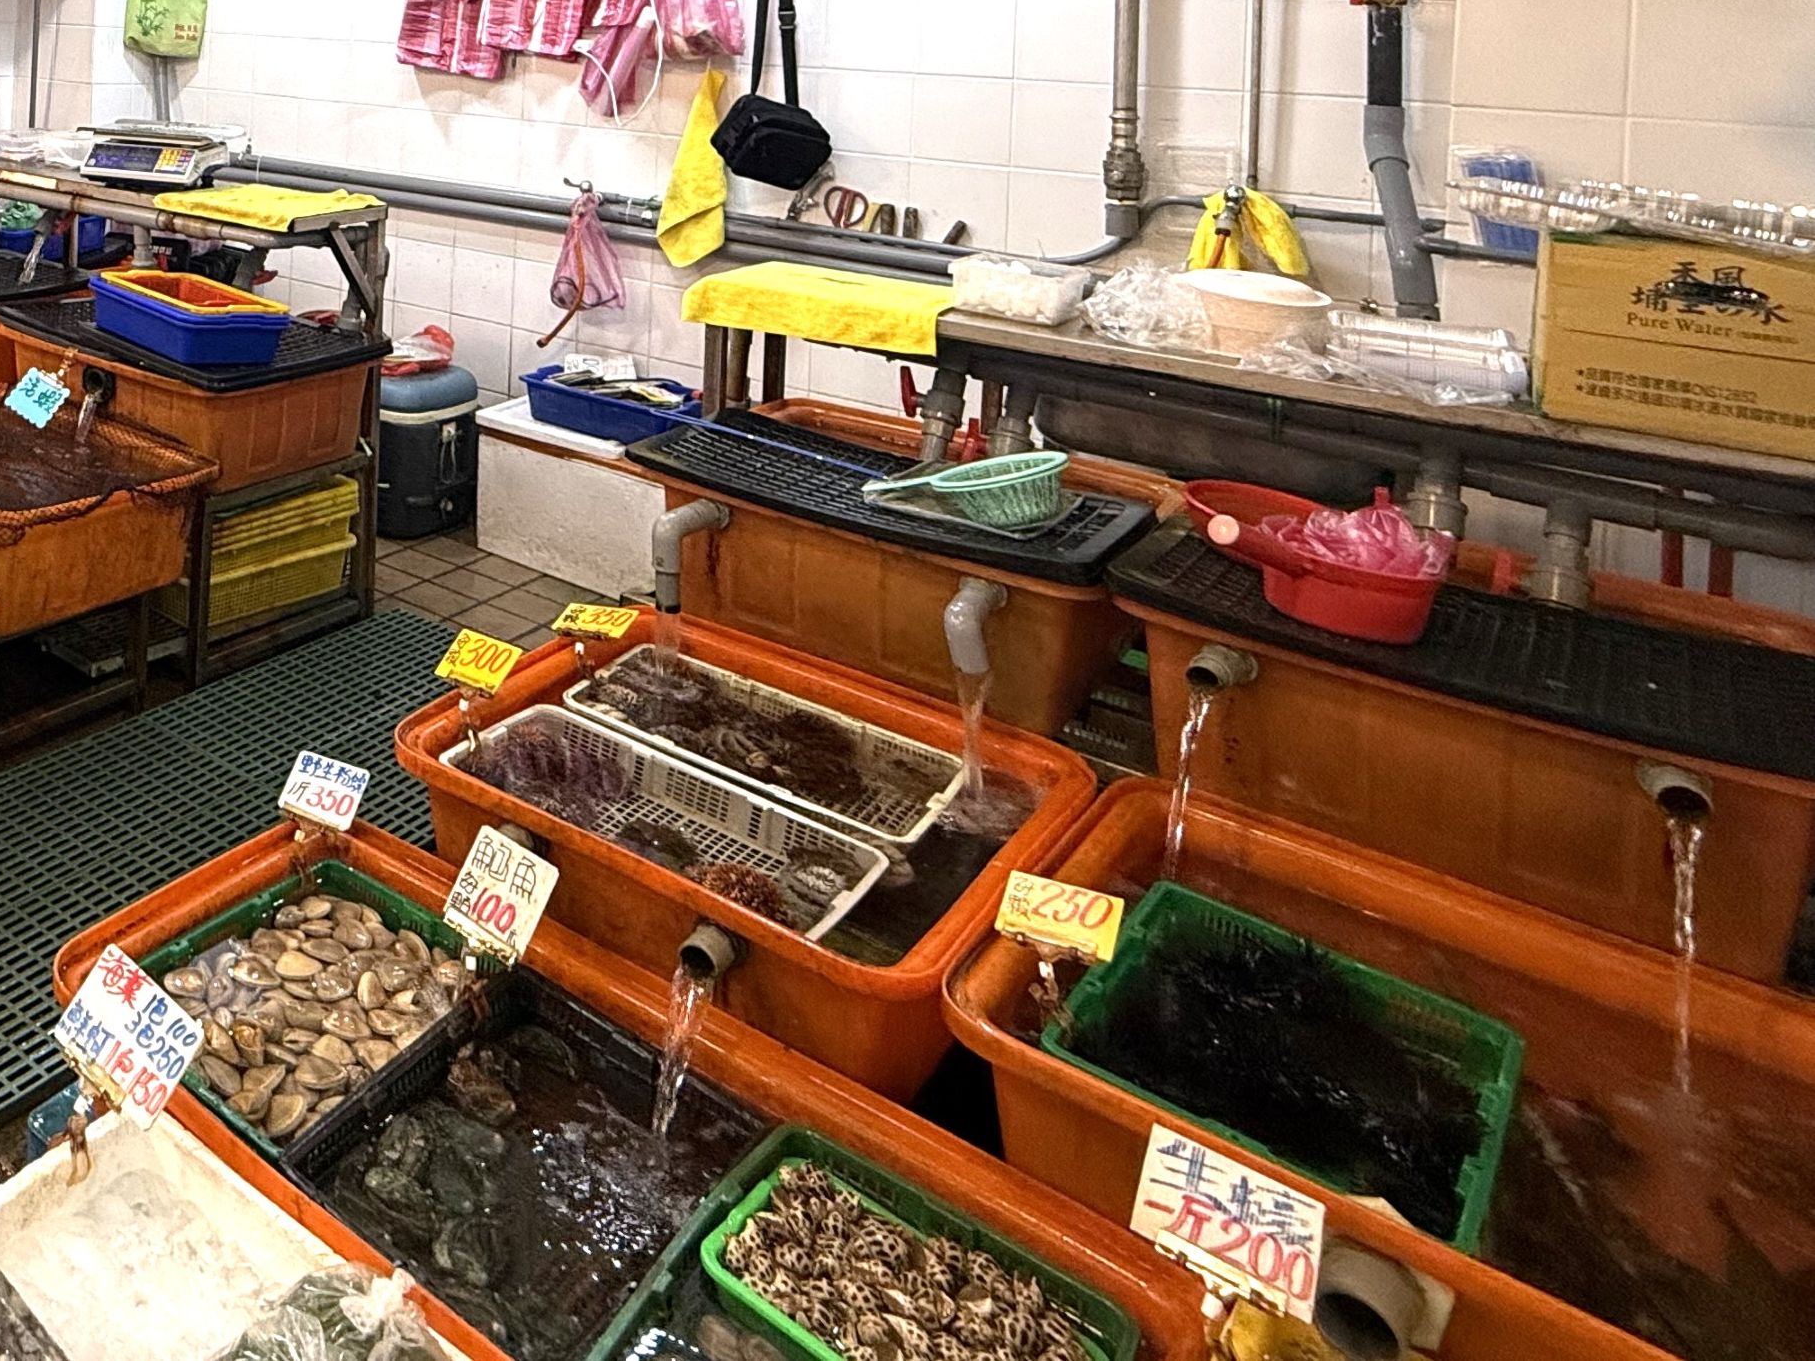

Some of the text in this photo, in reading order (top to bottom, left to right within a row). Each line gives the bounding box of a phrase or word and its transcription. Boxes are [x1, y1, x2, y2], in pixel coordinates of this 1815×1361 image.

[1626, 311, 1670, 331] Pure
[1675, 317, 1735, 339] Water
[582, 607, 634, 628] 350
[459, 637, 513, 675] 300
[471, 835, 537, 905] 鮑魚
[471, 886, 517, 936] 100
[1030, 882, 1114, 930] 250
